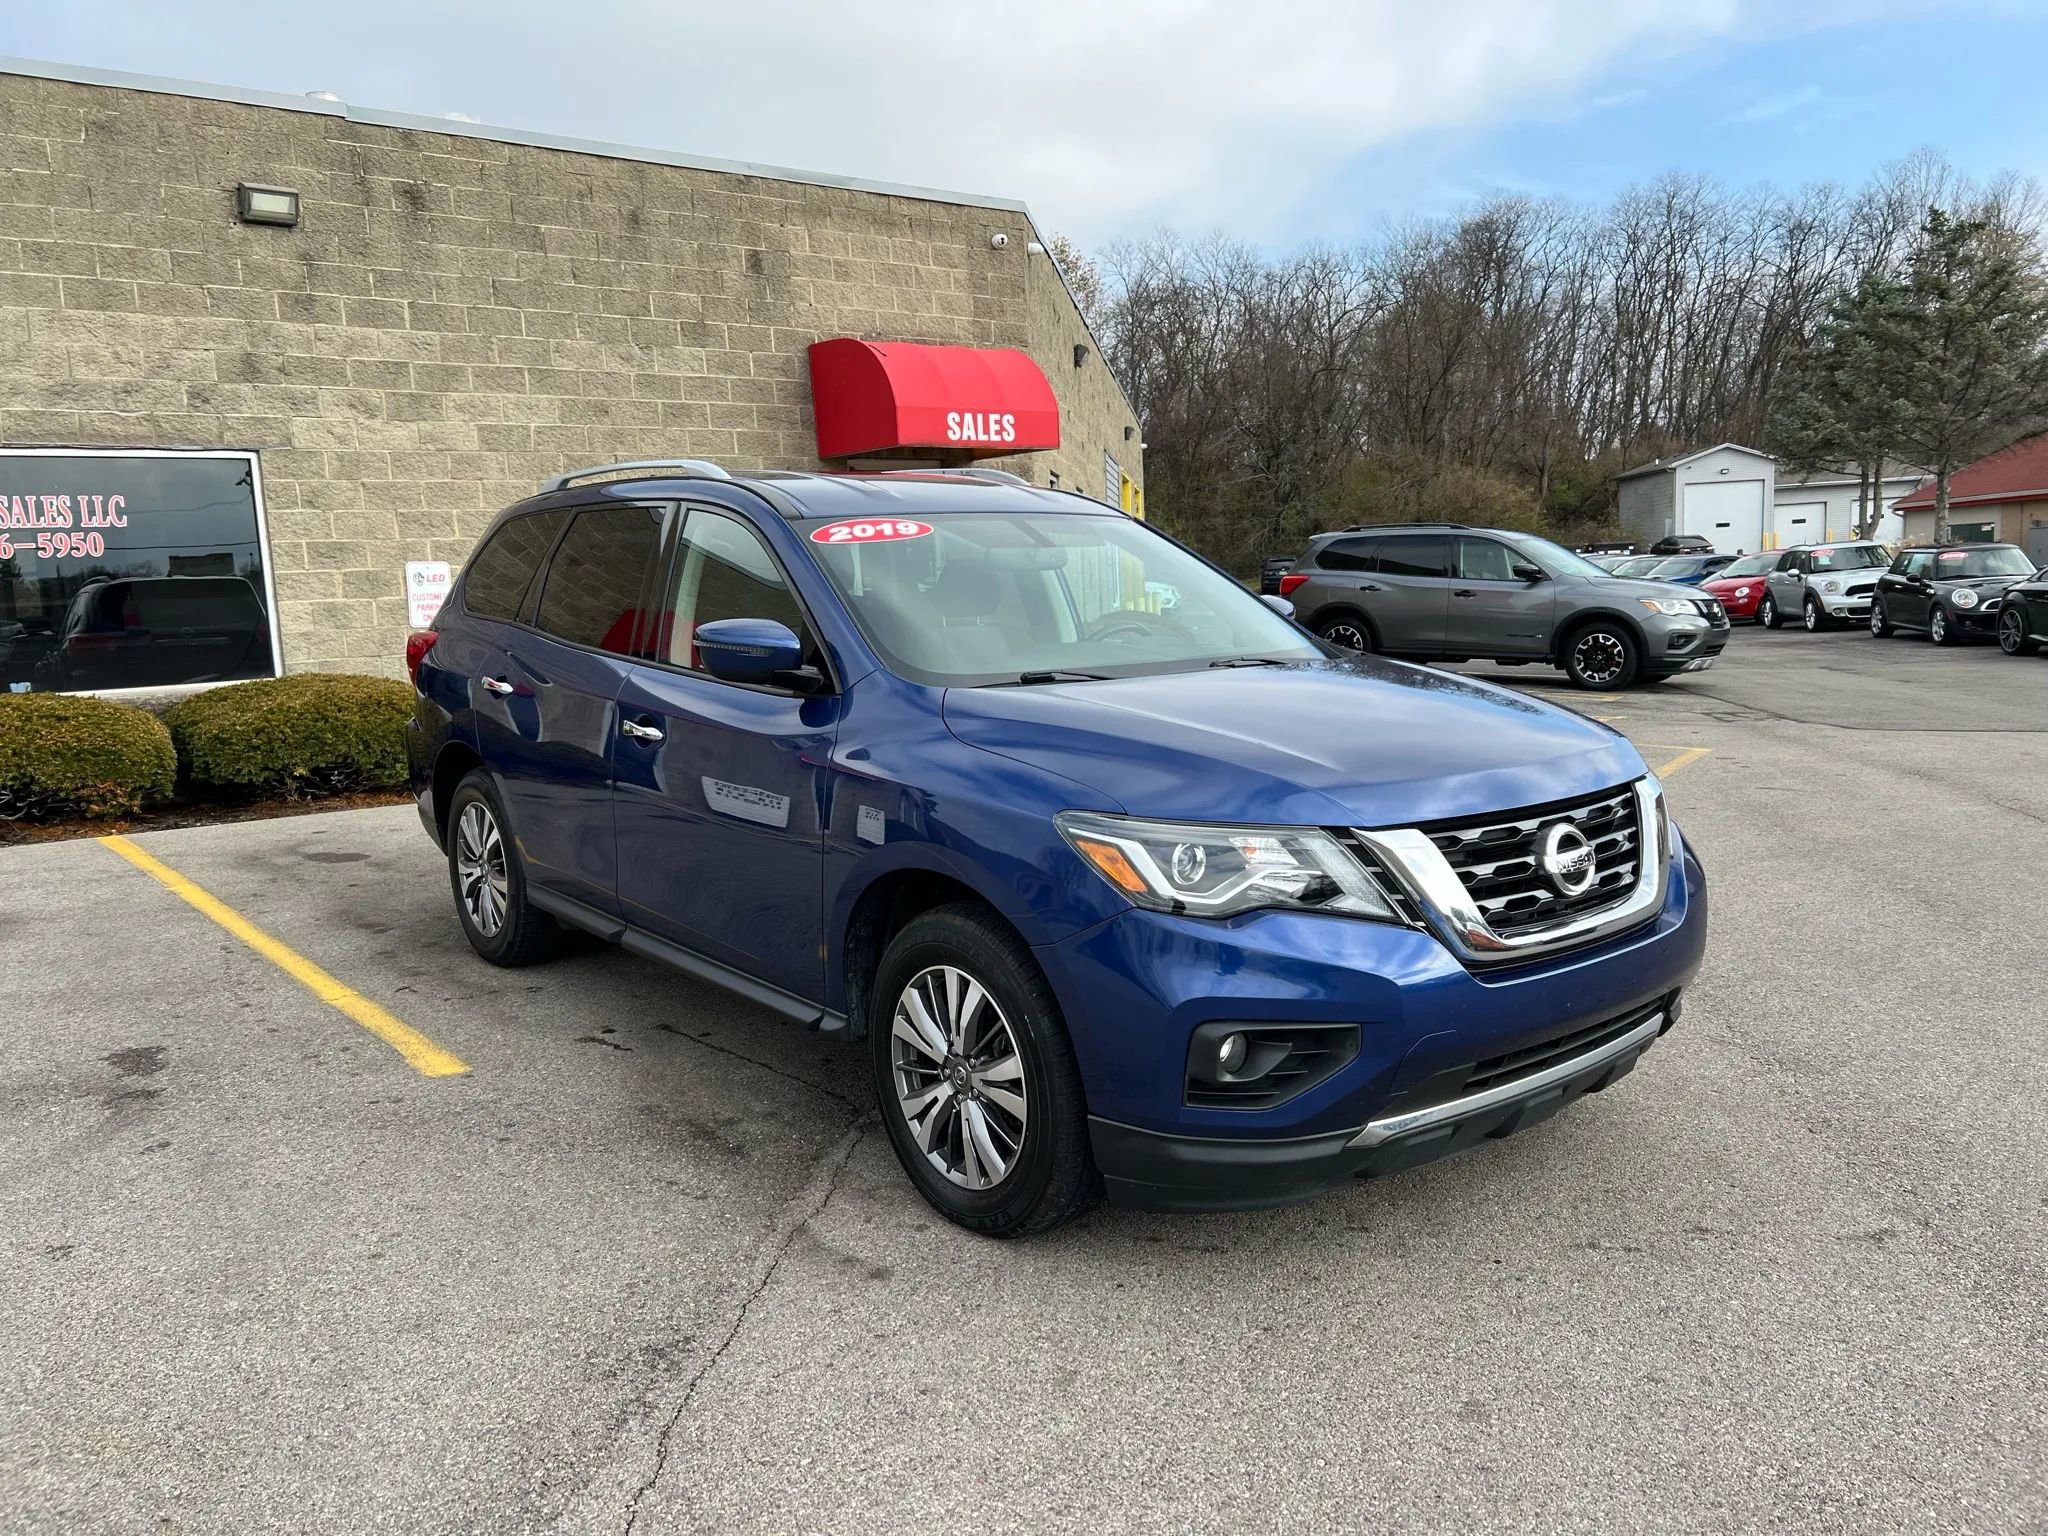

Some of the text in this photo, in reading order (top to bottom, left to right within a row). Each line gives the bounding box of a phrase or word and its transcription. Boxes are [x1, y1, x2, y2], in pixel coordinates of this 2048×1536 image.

[946, 412, 1015, 442] SALES
[0, 495, 127, 529] SALES LLC
[828, 521, 920, 541] 2019
[1557, 850, 1595, 870] NISSAN
